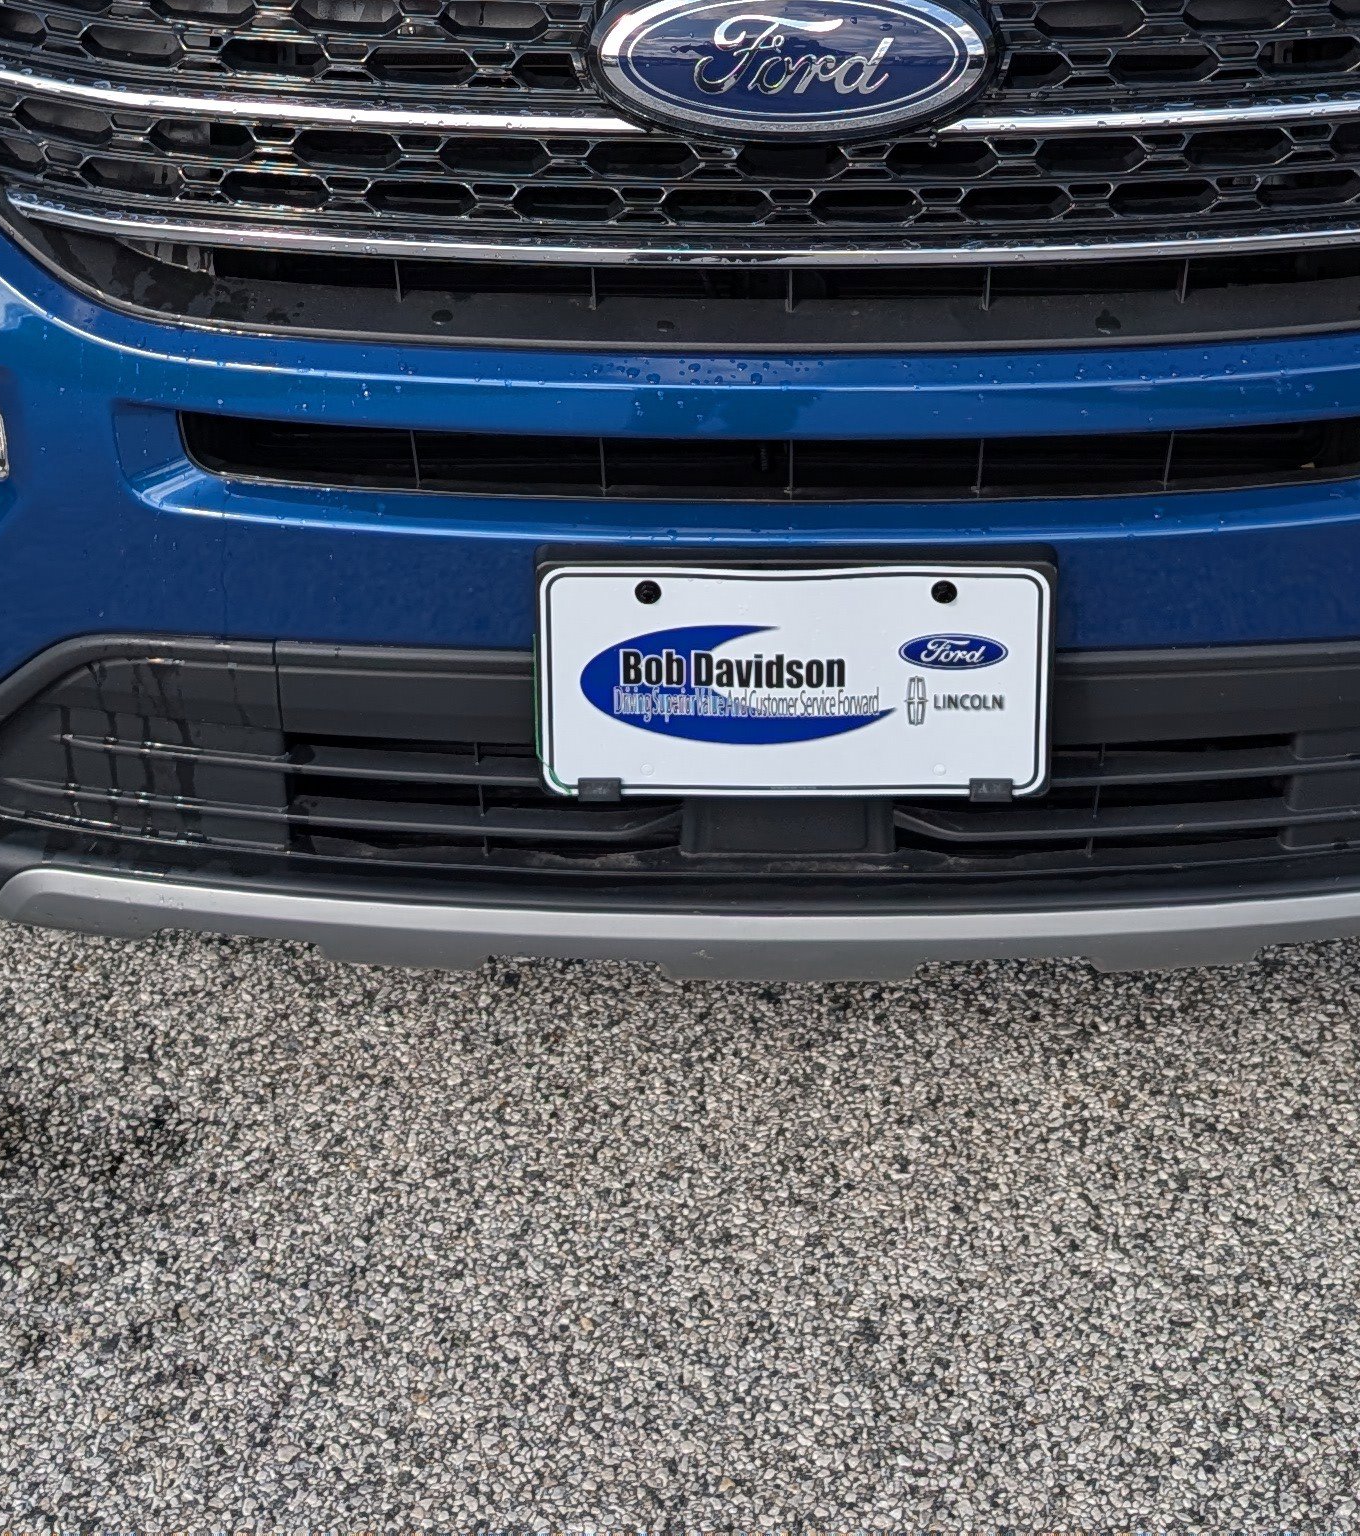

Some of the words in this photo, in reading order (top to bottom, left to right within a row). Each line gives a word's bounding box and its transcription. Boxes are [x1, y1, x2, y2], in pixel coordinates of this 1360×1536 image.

[693, 13, 895, 96] Ford
[920, 638, 987, 663] Ford
[621, 650, 685, 686] Bob
[693, 651, 846, 689] Davidson
[614, 686, 652, 722] Driving
[652, 687, 694, 722] Superior
[695, 687, 725, 716] Value
[725, 689, 747, 717] And
[748, 689, 798, 717] Customer
[799, 689, 837, 717] Service
[838, 686, 880, 716] Forward
[933, 693, 1005, 711] LINCOLN
